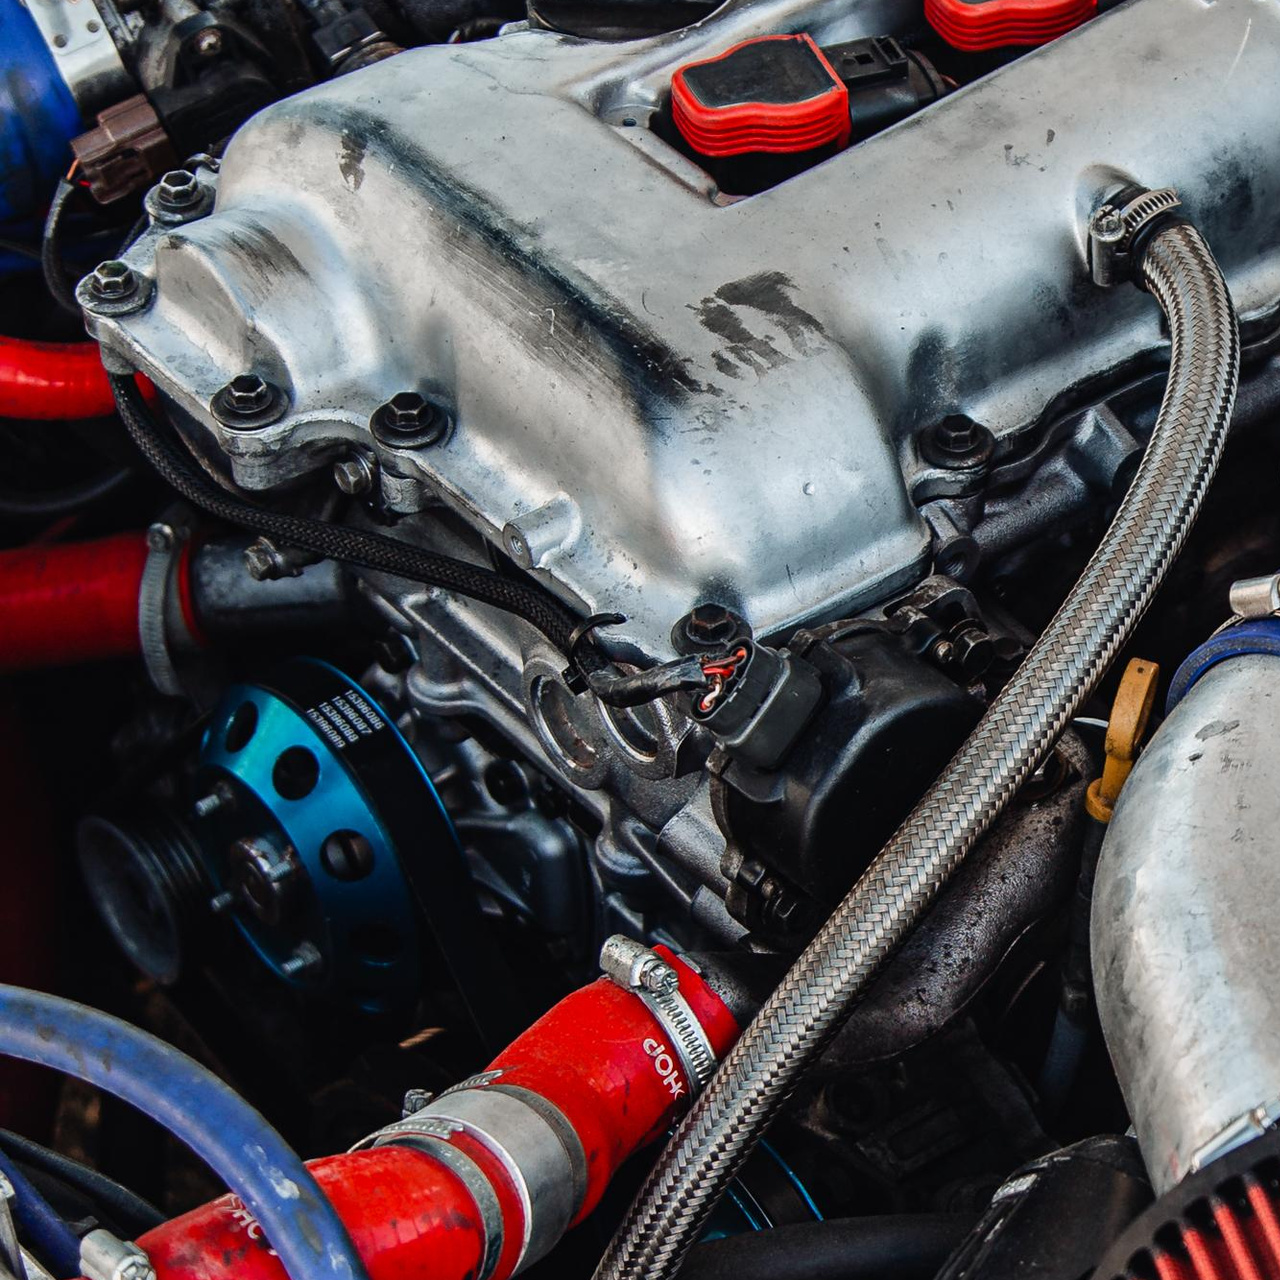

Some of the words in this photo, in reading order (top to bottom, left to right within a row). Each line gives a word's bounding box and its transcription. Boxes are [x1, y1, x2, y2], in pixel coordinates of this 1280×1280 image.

[318, 701, 359, 742] 15396088
[331, 695, 373, 734] 15396087
[344, 689, 385, 730] 15396086
